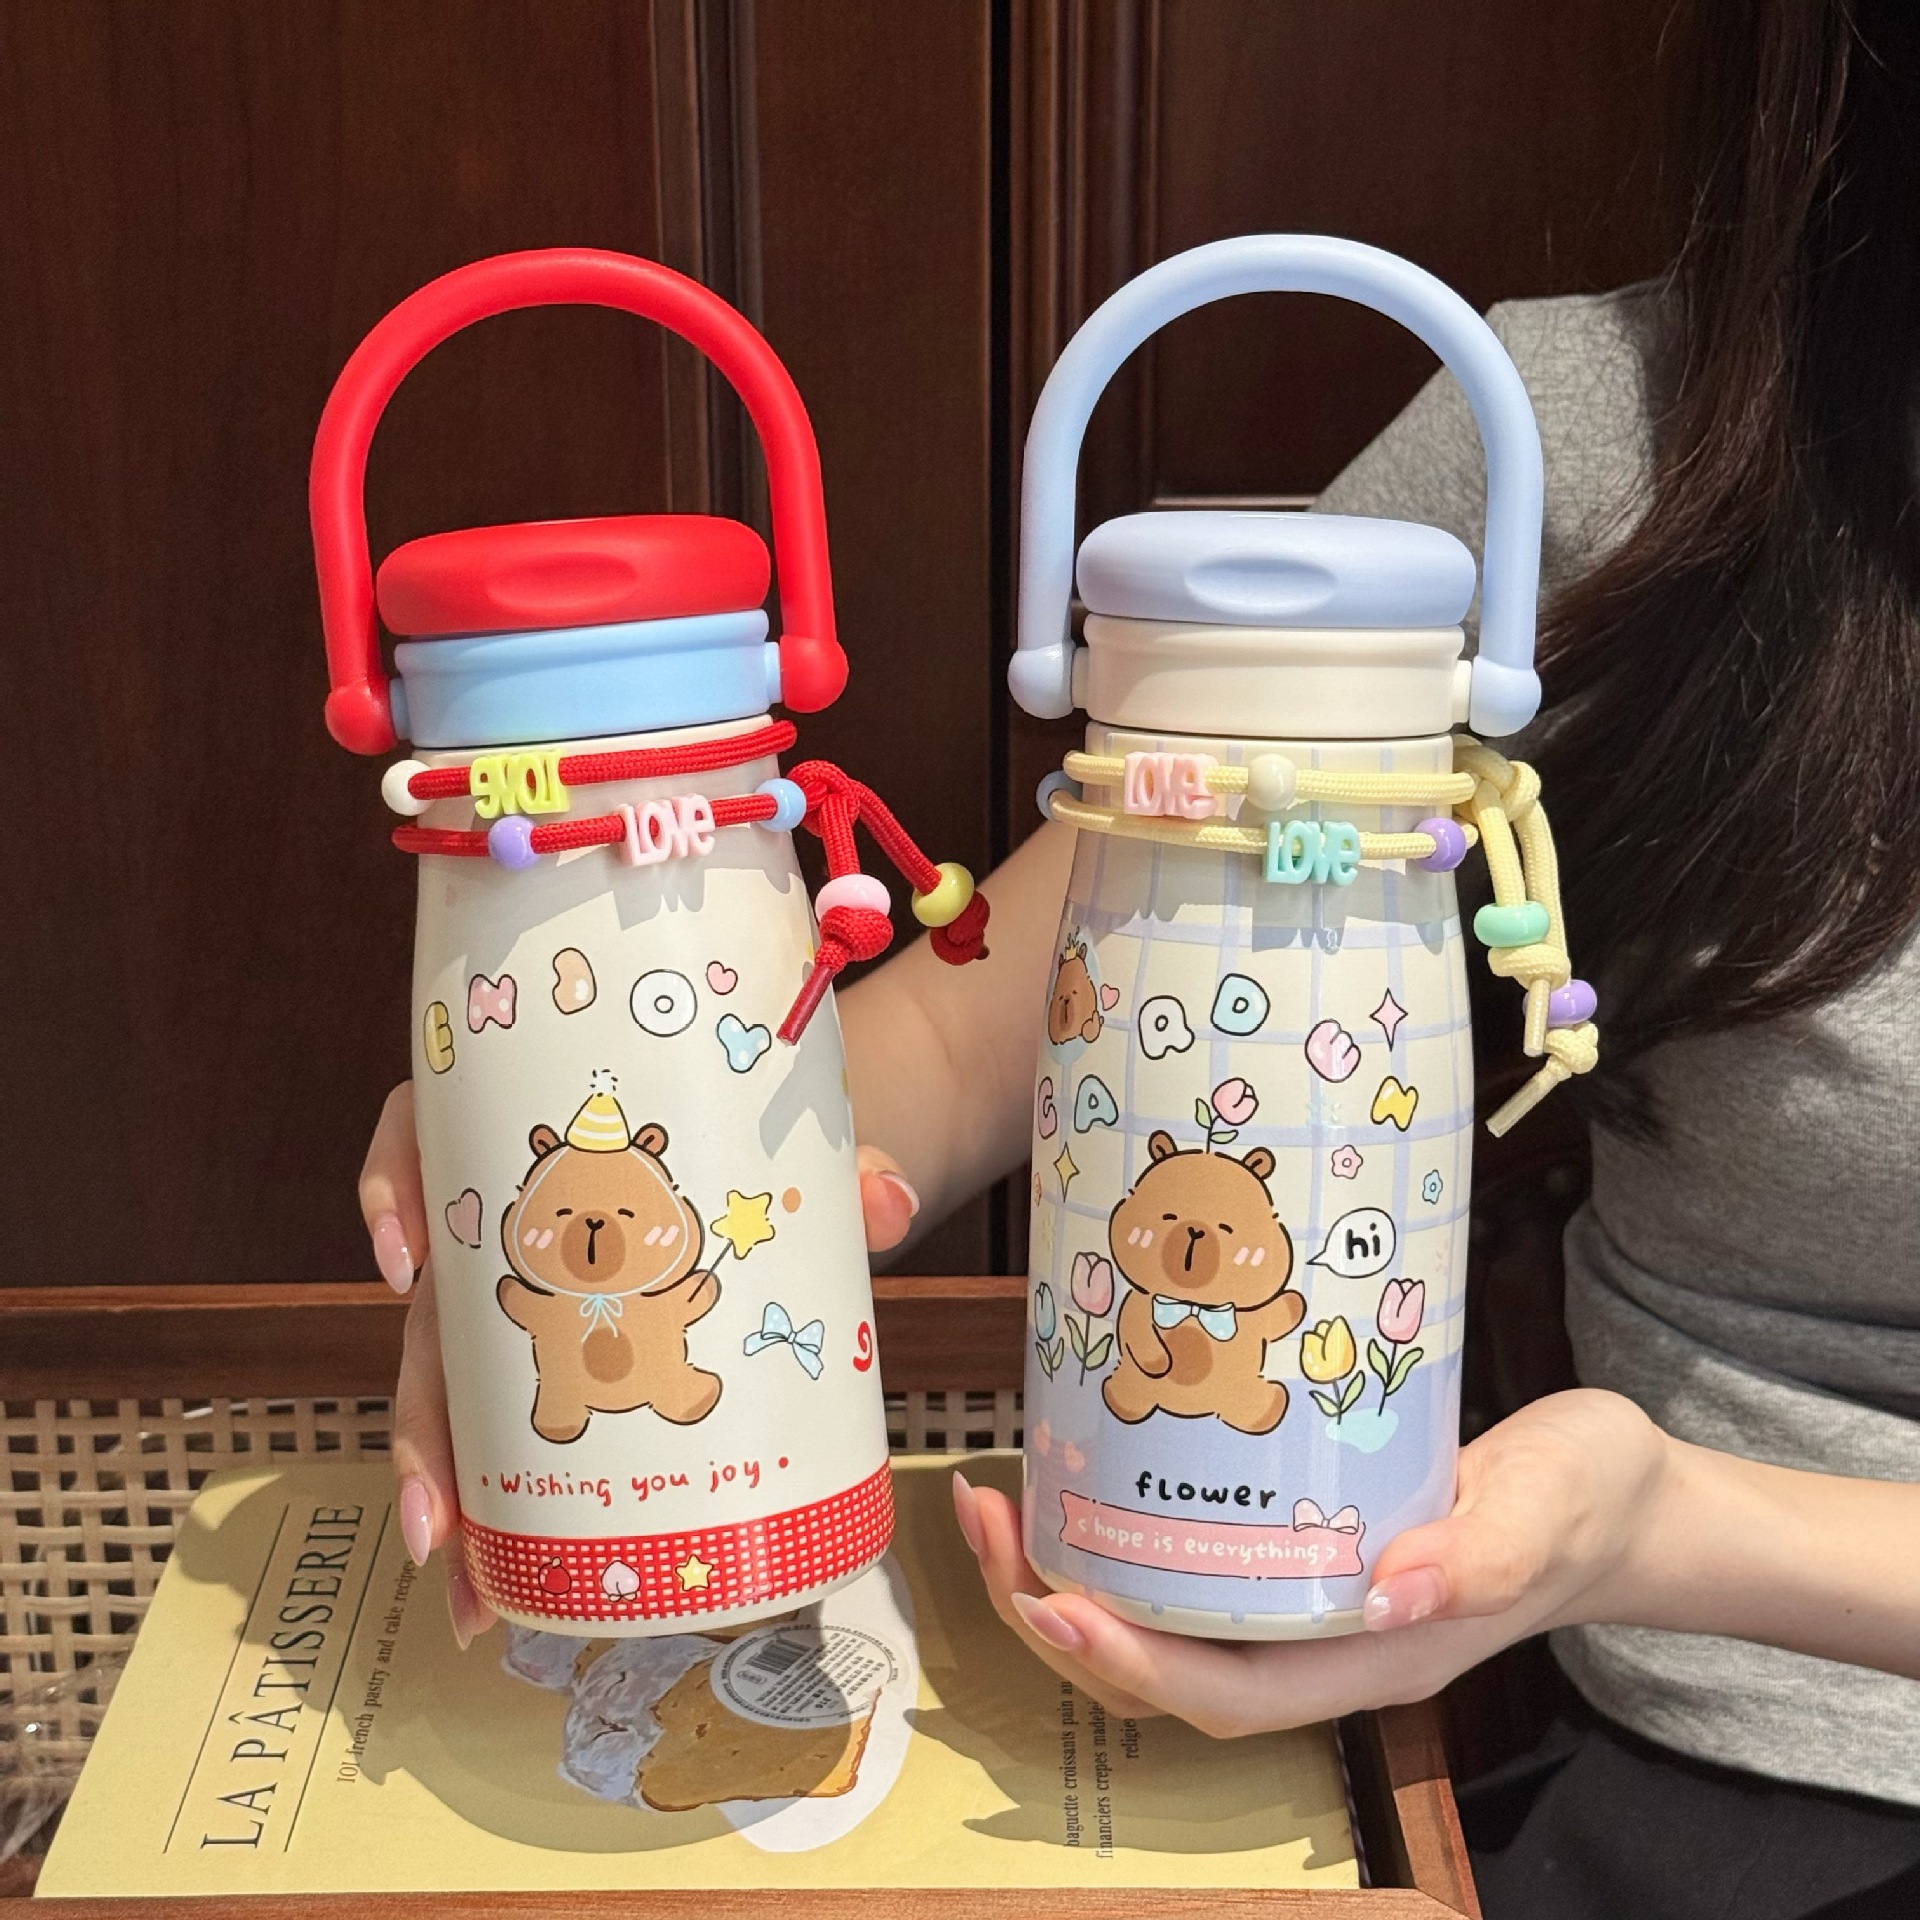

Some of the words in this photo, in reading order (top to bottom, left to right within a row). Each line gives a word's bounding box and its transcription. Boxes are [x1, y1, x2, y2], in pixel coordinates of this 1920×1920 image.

[1346, 1222, 1381, 1260] hi
[631, 1472, 690, 1502] you
[709, 1460, 760, 1493] joy
[1135, 1470, 1277, 1509] flower
[1093, 1514, 1145, 1549] hope
[1152, 1529, 1173, 1553] is
[1184, 1535, 1319, 1566] everything
[394, 1558, 418, 1601] recipes
[227, 1503, 366, 1763] PÂTISSERIE
[383, 1601, 406, 1634] cake
[376, 1638, 398, 1665] and
[363, 1666, 393, 1709] pastry
[345, 1712, 375, 1757] french
[1056, 1699, 1079, 1727] pain
[1058, 1728, 1080, 1789] croissants
[1093, 1750, 1114, 1792] crepes
[199, 1781, 278, 1850] LA
[1063, 1793, 1085, 1847] baguette
[1091, 1795, 1114, 1859] financiers
